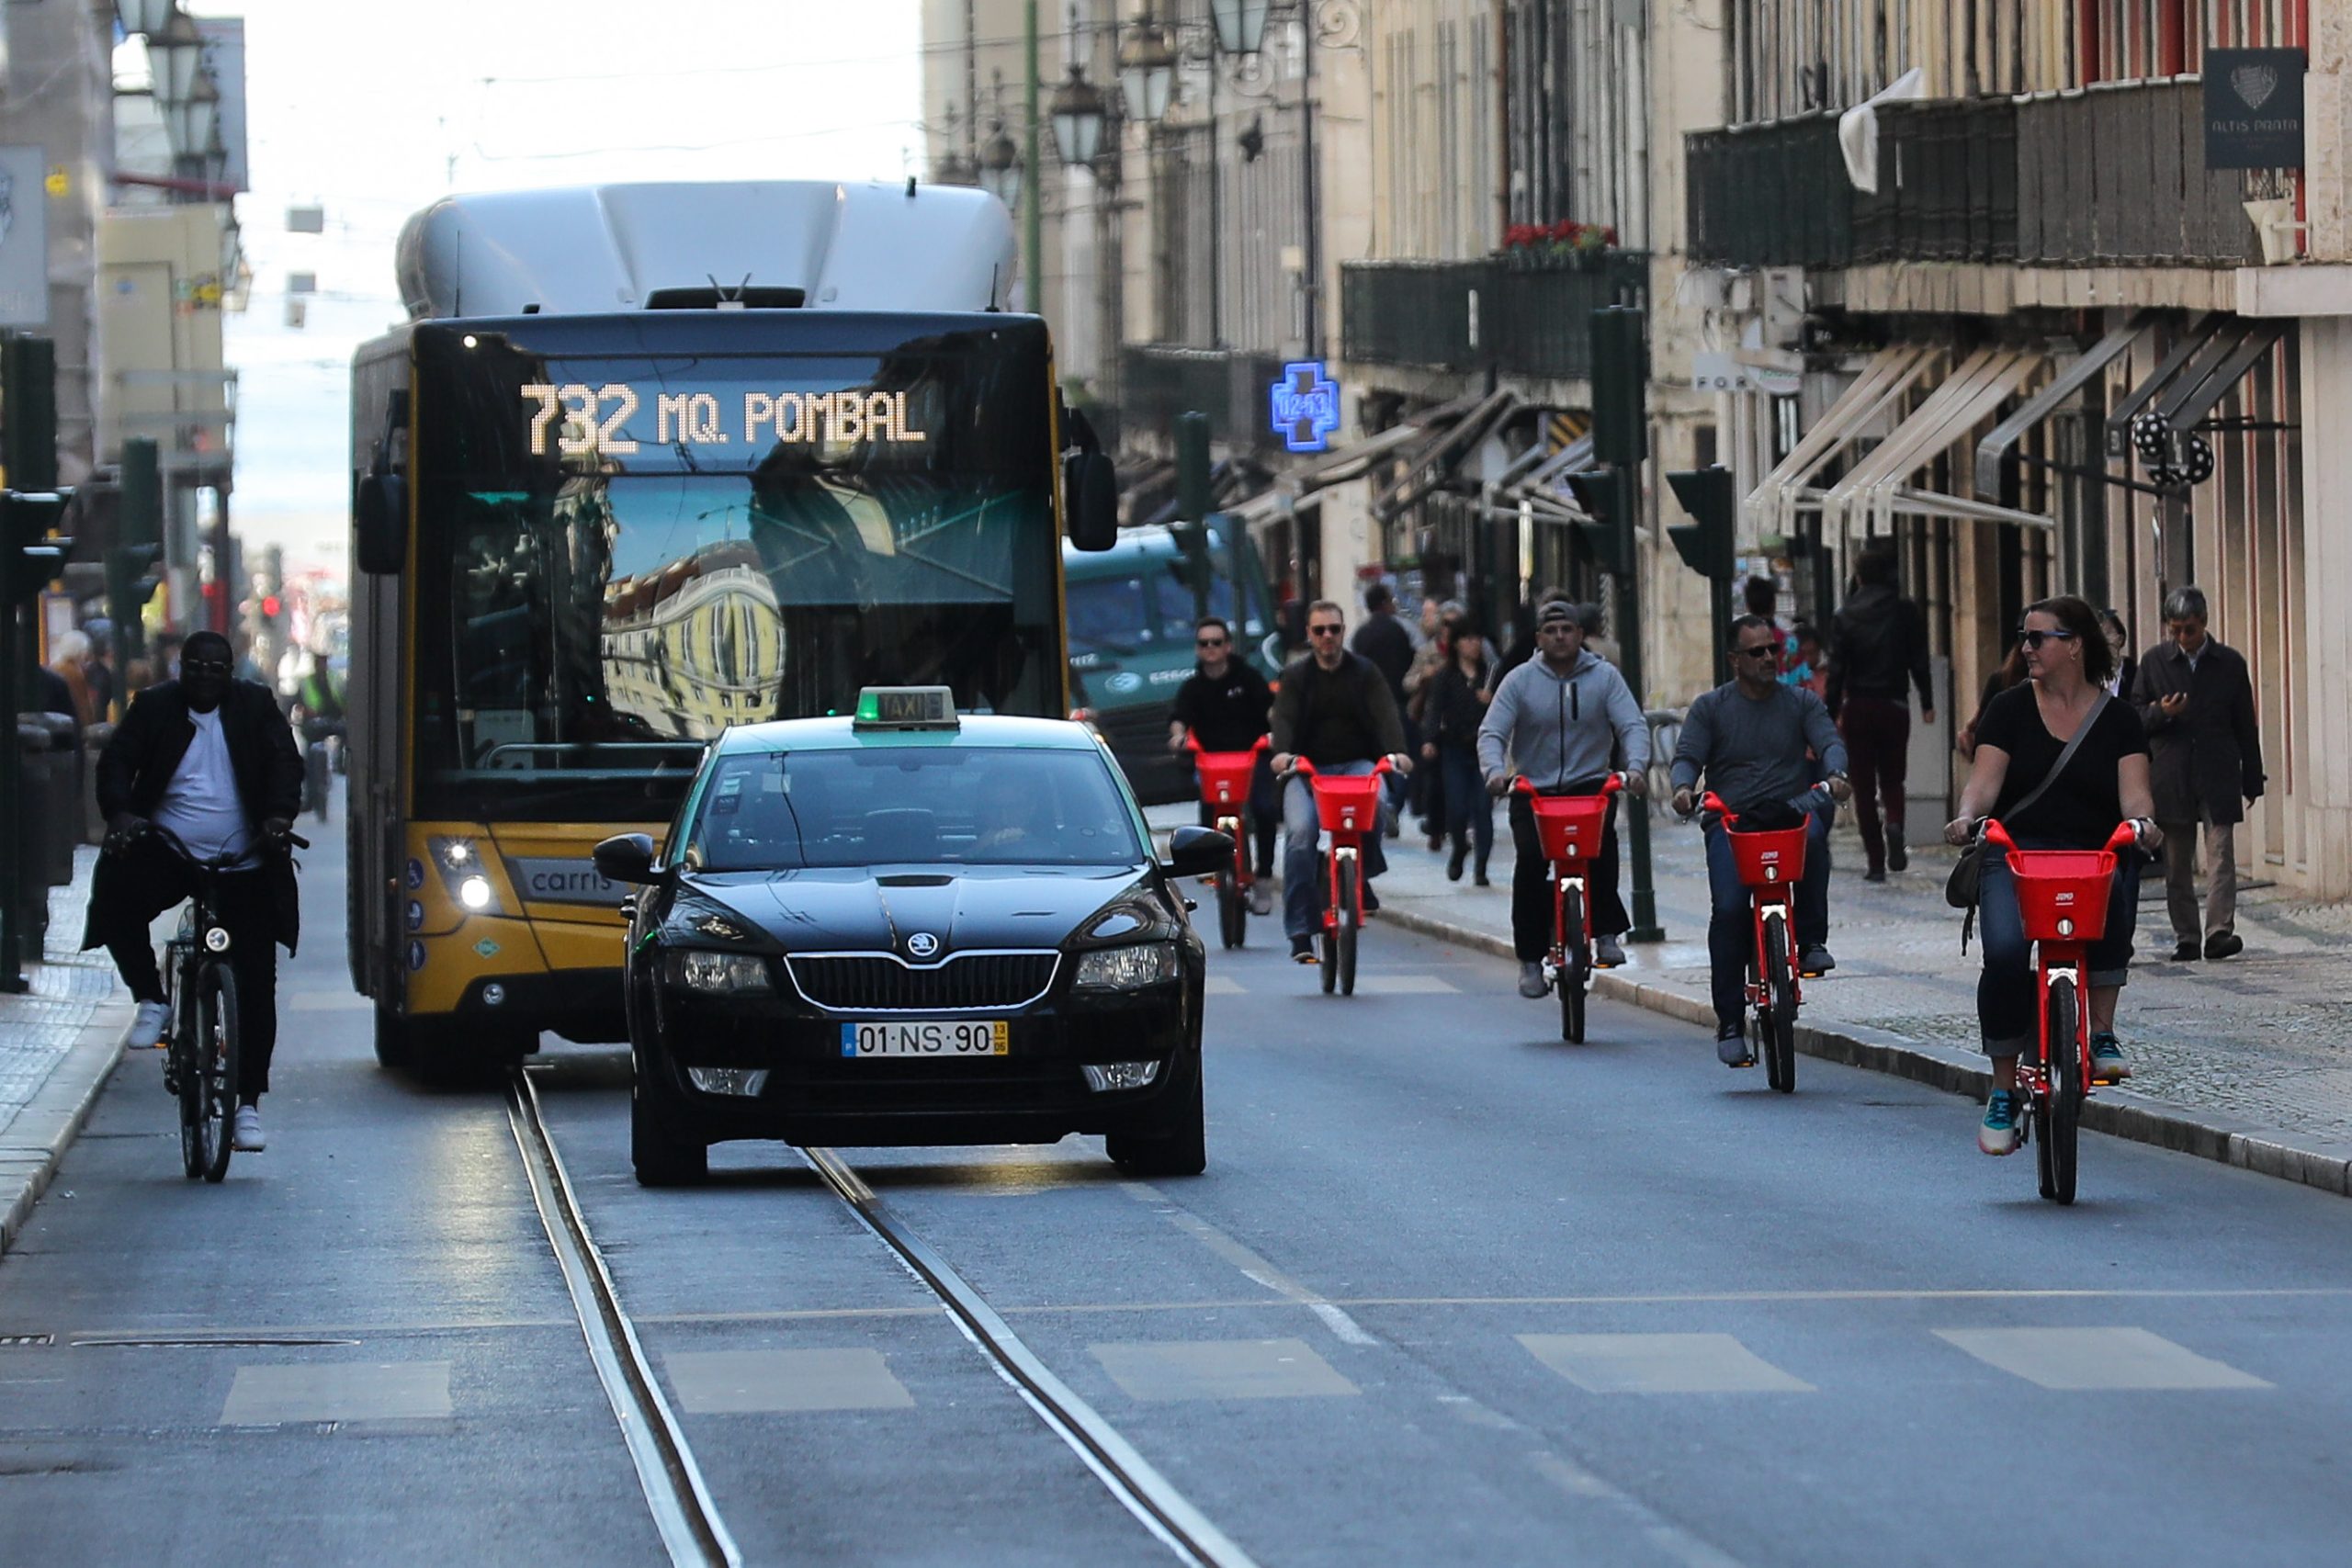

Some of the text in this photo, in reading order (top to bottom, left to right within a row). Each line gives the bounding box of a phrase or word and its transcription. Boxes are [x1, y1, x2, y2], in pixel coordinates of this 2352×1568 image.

[2212, 119, 2298, 132] ALTIS PRATA
[520, 383, 927, 456] 732 MQ. POMBAL
[880, 694, 924, 717] TAXI
[532, 871, 612, 891] carris
